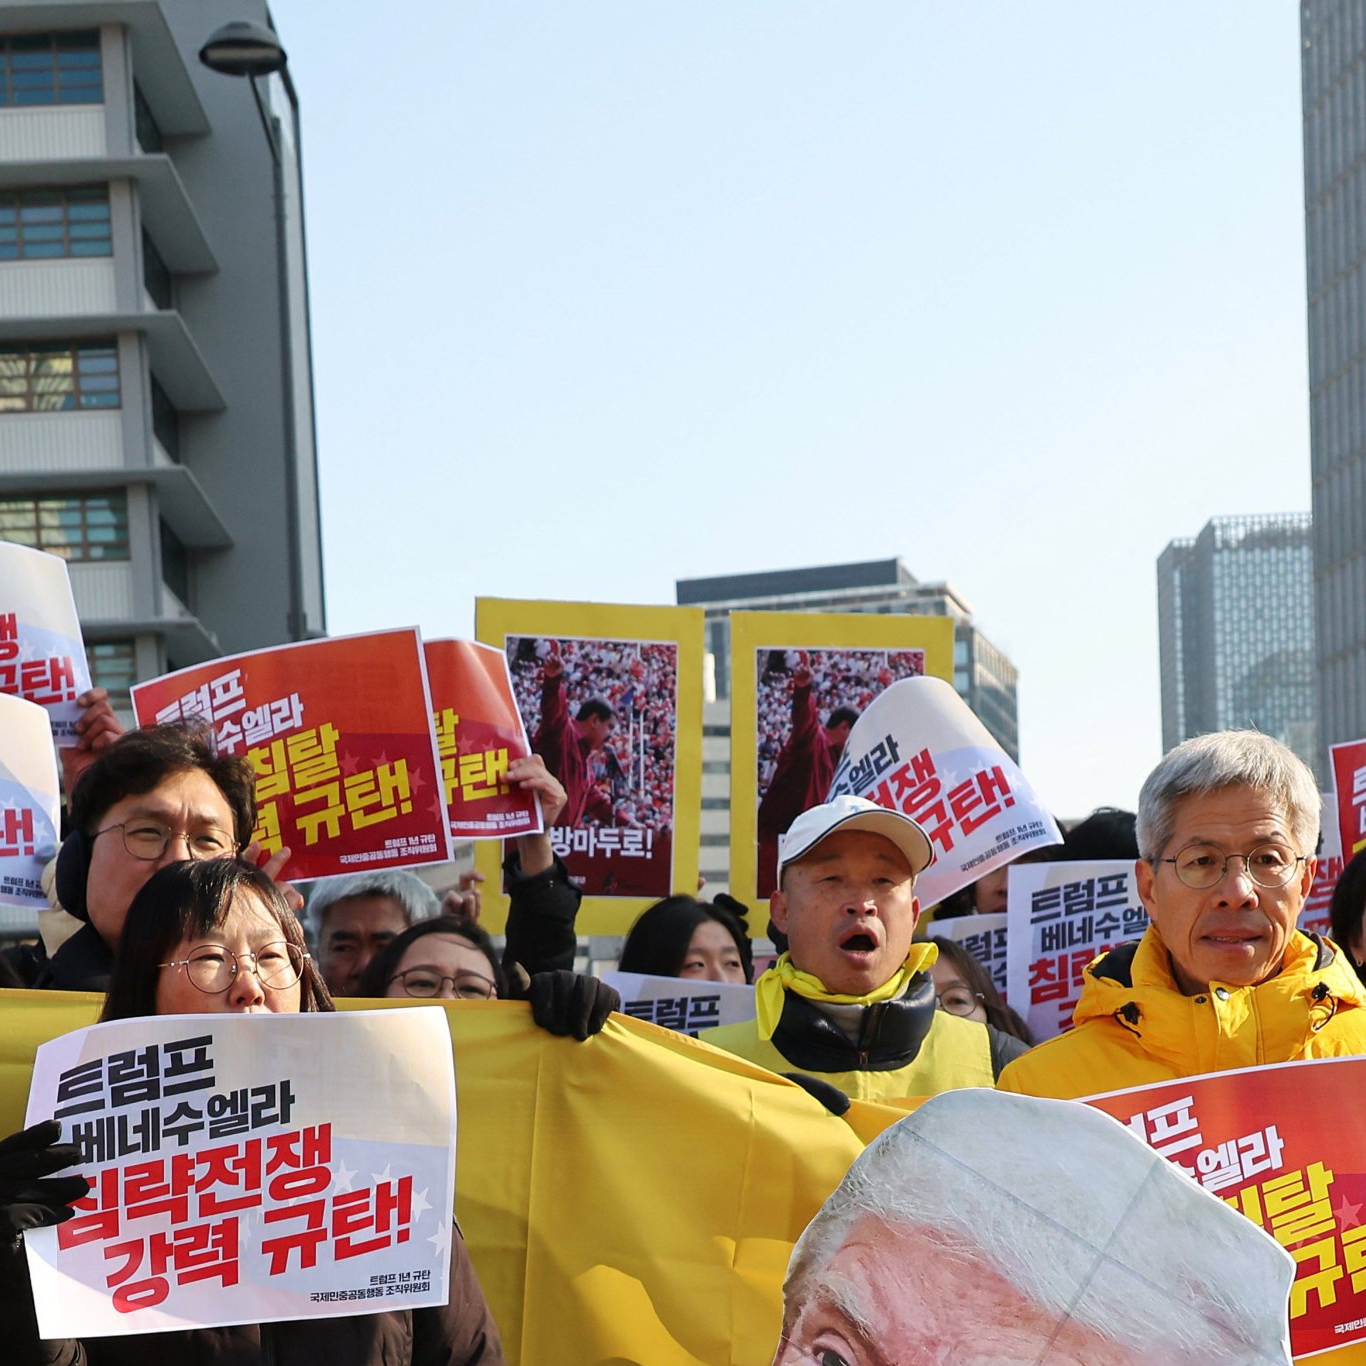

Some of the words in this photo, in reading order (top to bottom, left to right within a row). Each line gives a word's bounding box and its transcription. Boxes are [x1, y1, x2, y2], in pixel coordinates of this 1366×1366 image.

[211, 692, 304, 756] 수엘라
[247, 722, 340, 802] 침탈
[294, 759, 411, 846] 규탄!
[549, 826, 653, 860] 방마두로!
[1030, 873, 1128, 924] 트럼프
[1041, 906, 1148, 953] 베네수엘
[624, 995, 720, 1029] 트럼프
[53, 1035, 215, 1119] 트럼프
[72, 1080, 296, 1164] 베네수엘라
[56, 1123, 333, 1251] 침략전쟁
[103, 1217, 239, 1314] 강력
[261, 1176, 414, 1276] 규탄!
[370, 1274, 397, 1286] 트럼프
[398, 1272, 411, 1283] 1년
[413, 1269, 431, 1281] 규탄
[385, 1281, 430, 1297] 조직위원회
